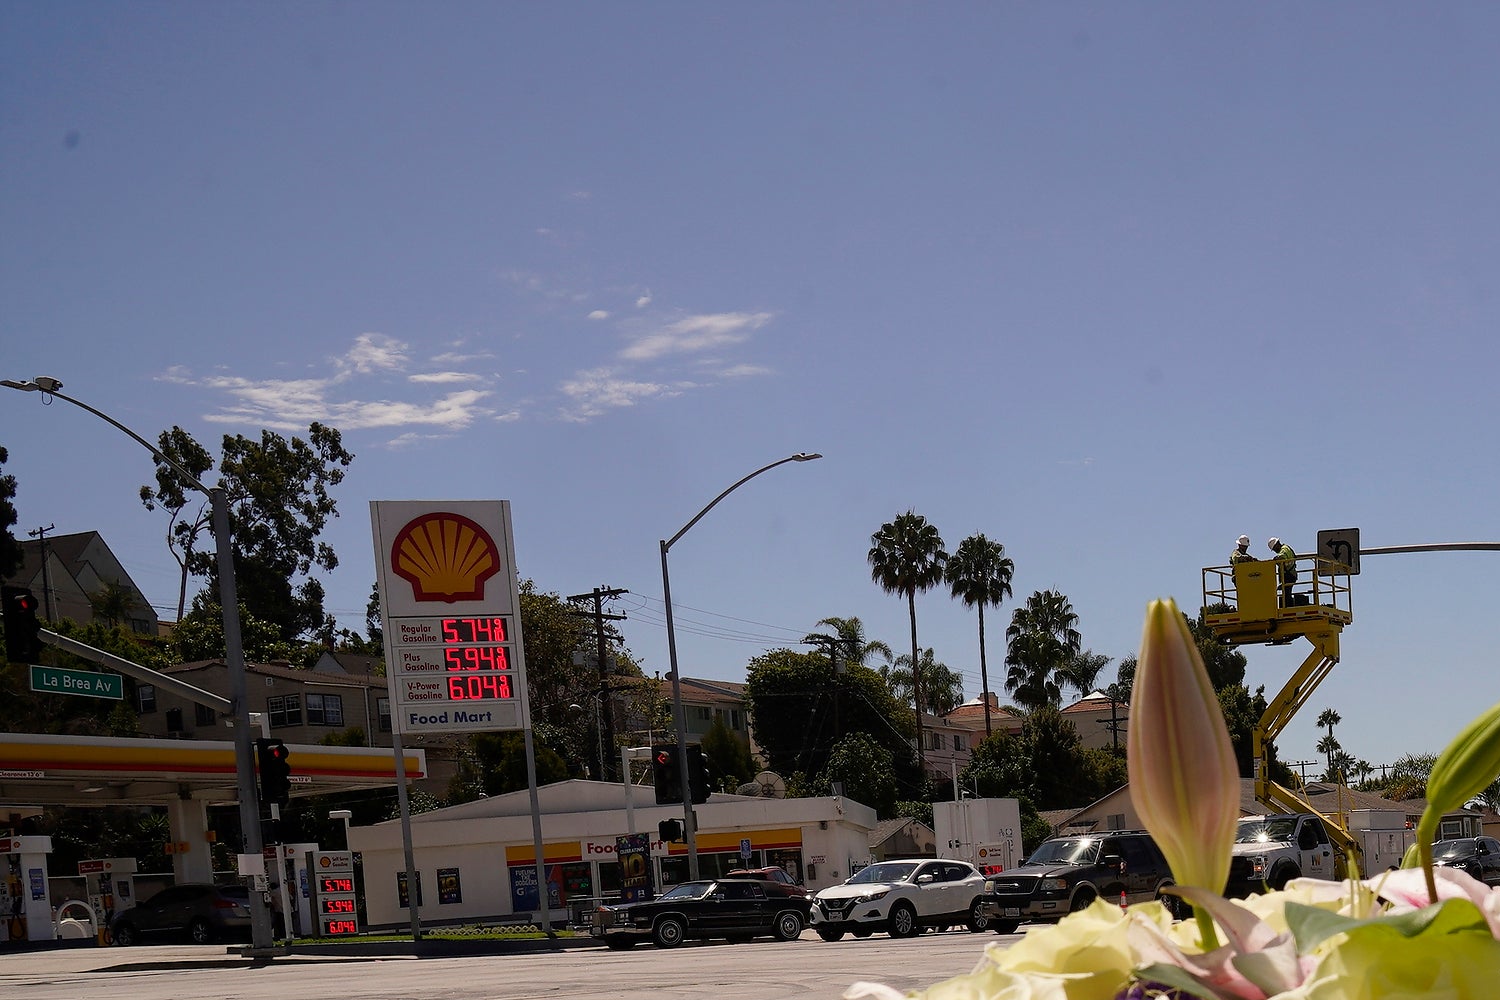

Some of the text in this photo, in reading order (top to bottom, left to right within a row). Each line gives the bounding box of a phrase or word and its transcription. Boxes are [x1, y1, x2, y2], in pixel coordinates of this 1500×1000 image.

[401, 624, 431, 635] Regular
[402, 634, 437, 643] Gasoline
[404, 653, 421, 662] Plus
[405, 662, 440, 671] Gasoline
[43, 673, 112, 692] La Brea Av
[407, 682, 440, 691] V-Power
[408, 691, 443, 700] Gasoline
[410, 711, 492, 725] Food Mart
[516, 888, 525, 896] G
